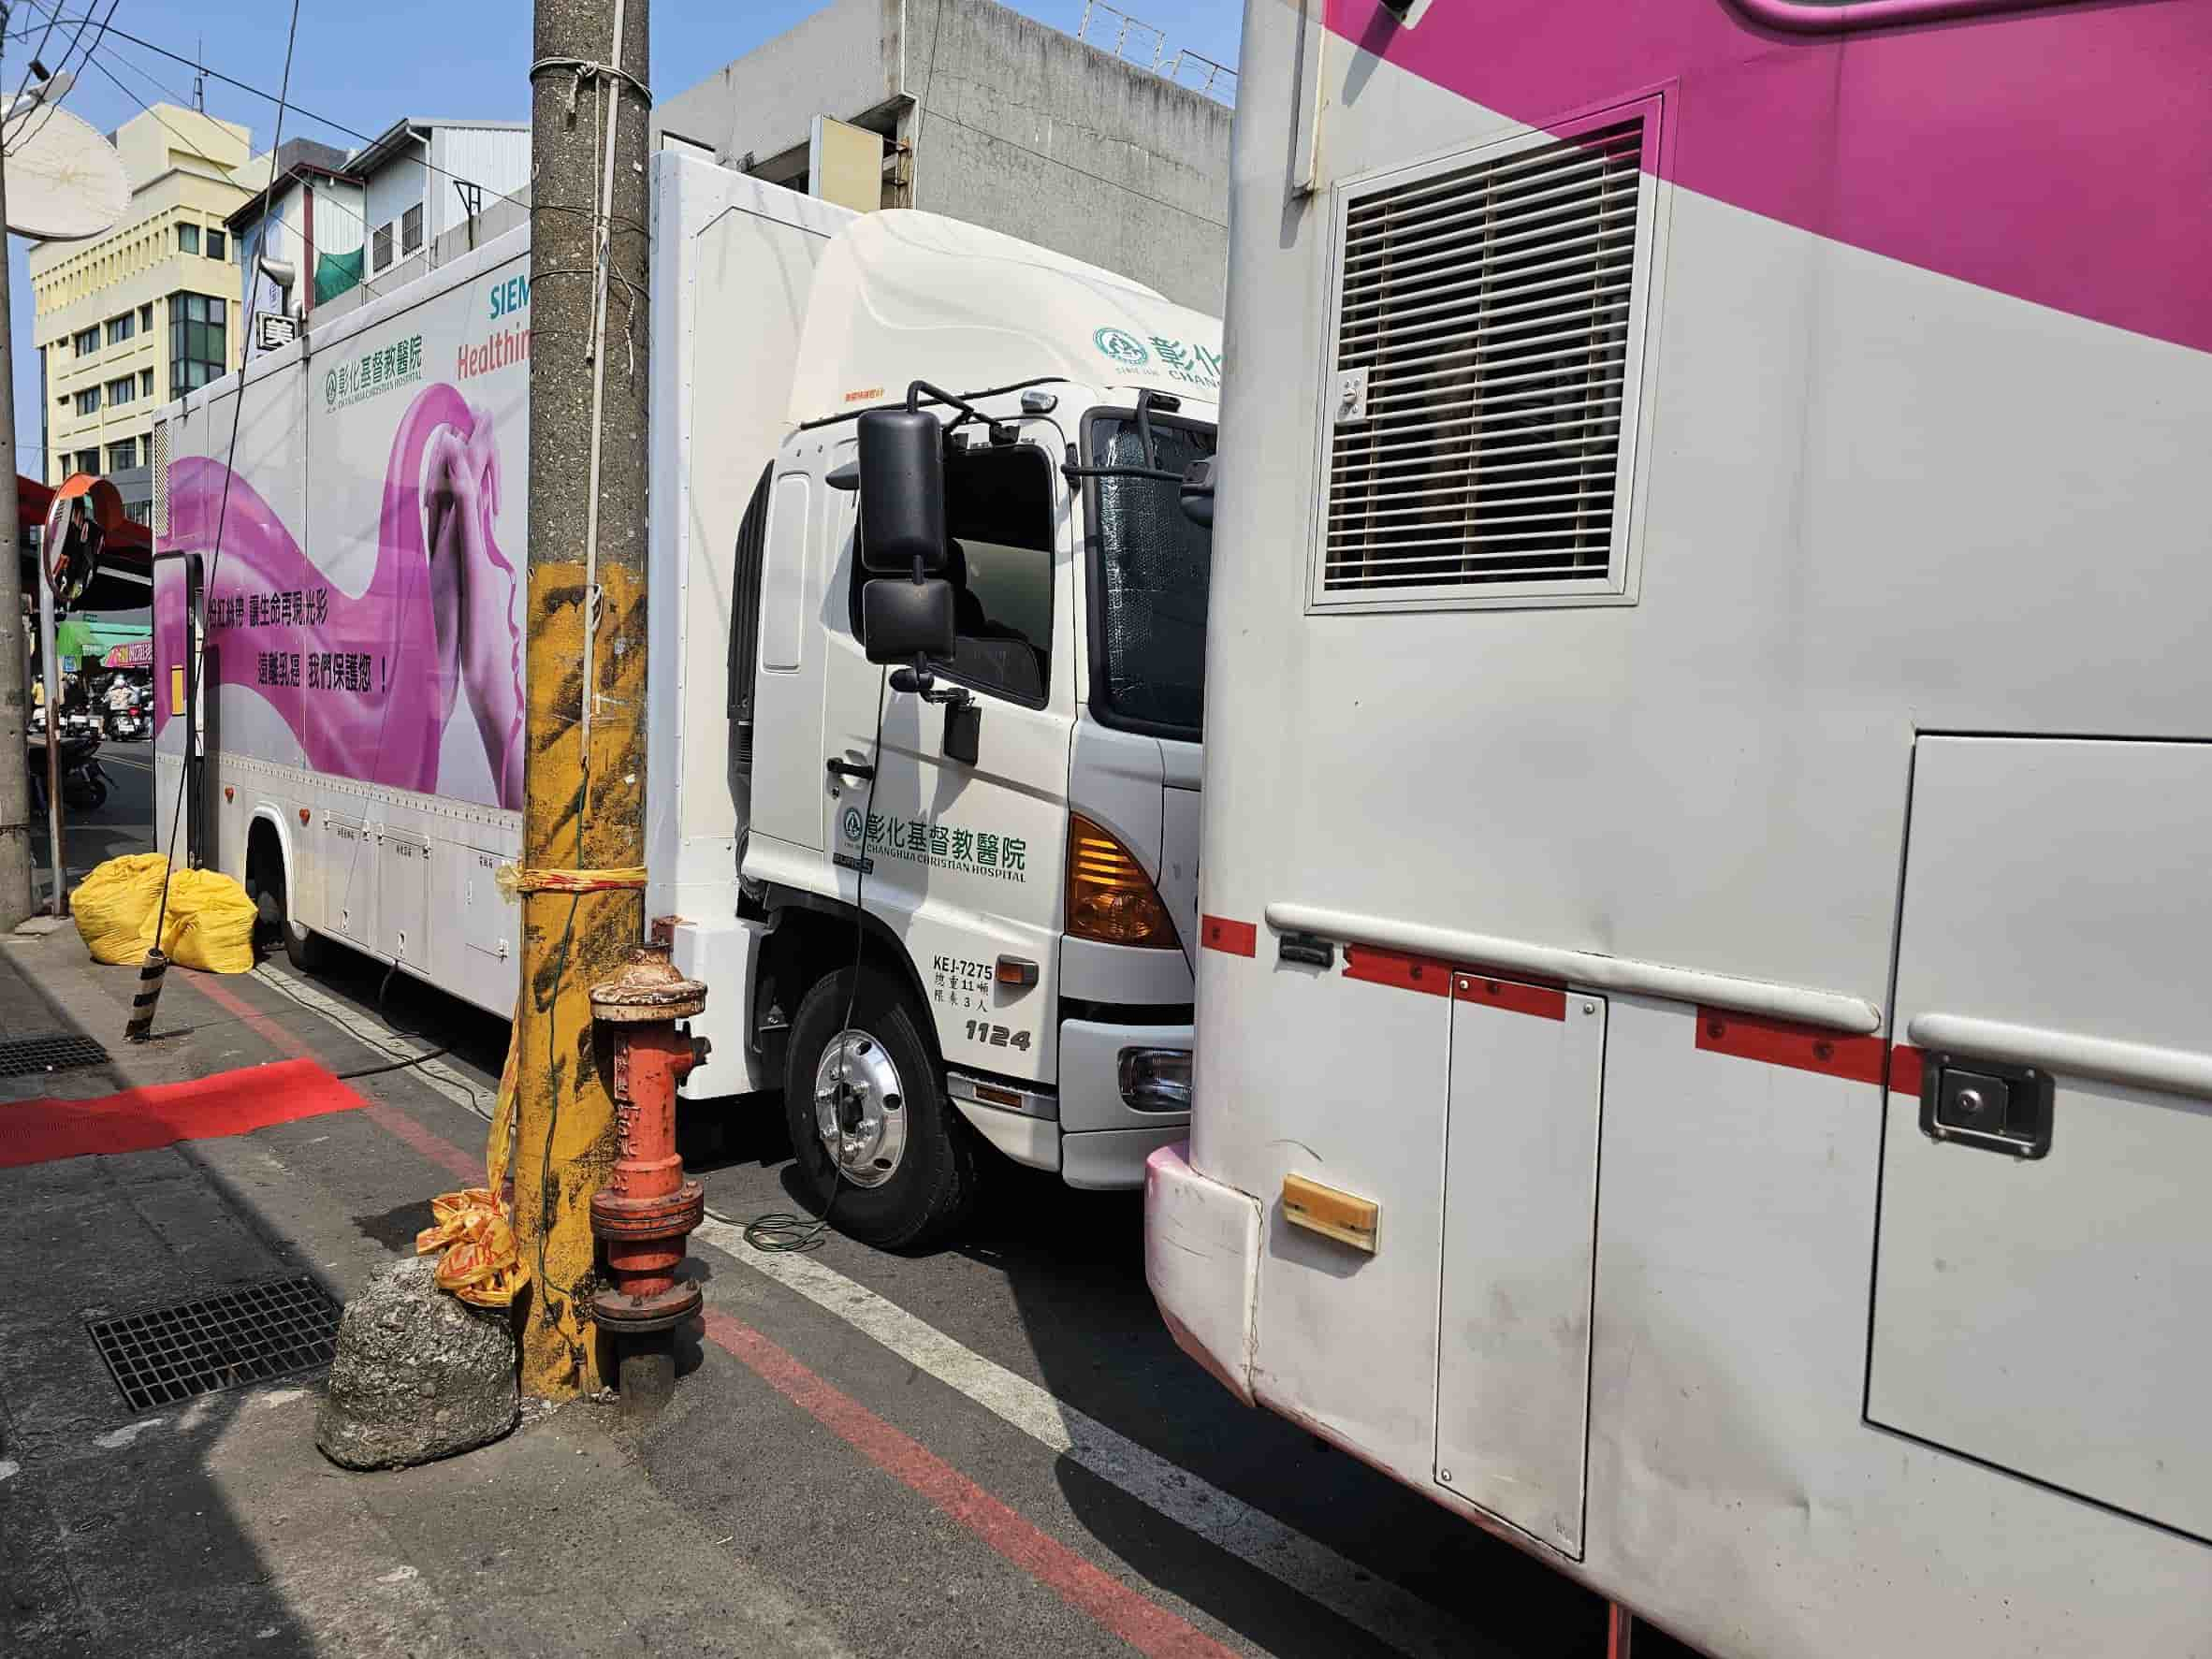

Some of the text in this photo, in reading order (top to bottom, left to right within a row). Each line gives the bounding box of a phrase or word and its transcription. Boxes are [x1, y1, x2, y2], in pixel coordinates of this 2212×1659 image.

[338, 334, 422, 396] 彰化基督教醫院
[249, 588, 327, 629] 讓生命再現光彩
[866, 813, 1026, 871] 彰化基督教醫院
[866, 844, 916, 863] CHANGHUA
[917, 852, 969, 873] CHRISTIAN
[972, 865, 1026, 883] HOSPITAL
[934, 954, 992, 981] KEJ-7275
[966, 1020, 1031, 1052] 1124
